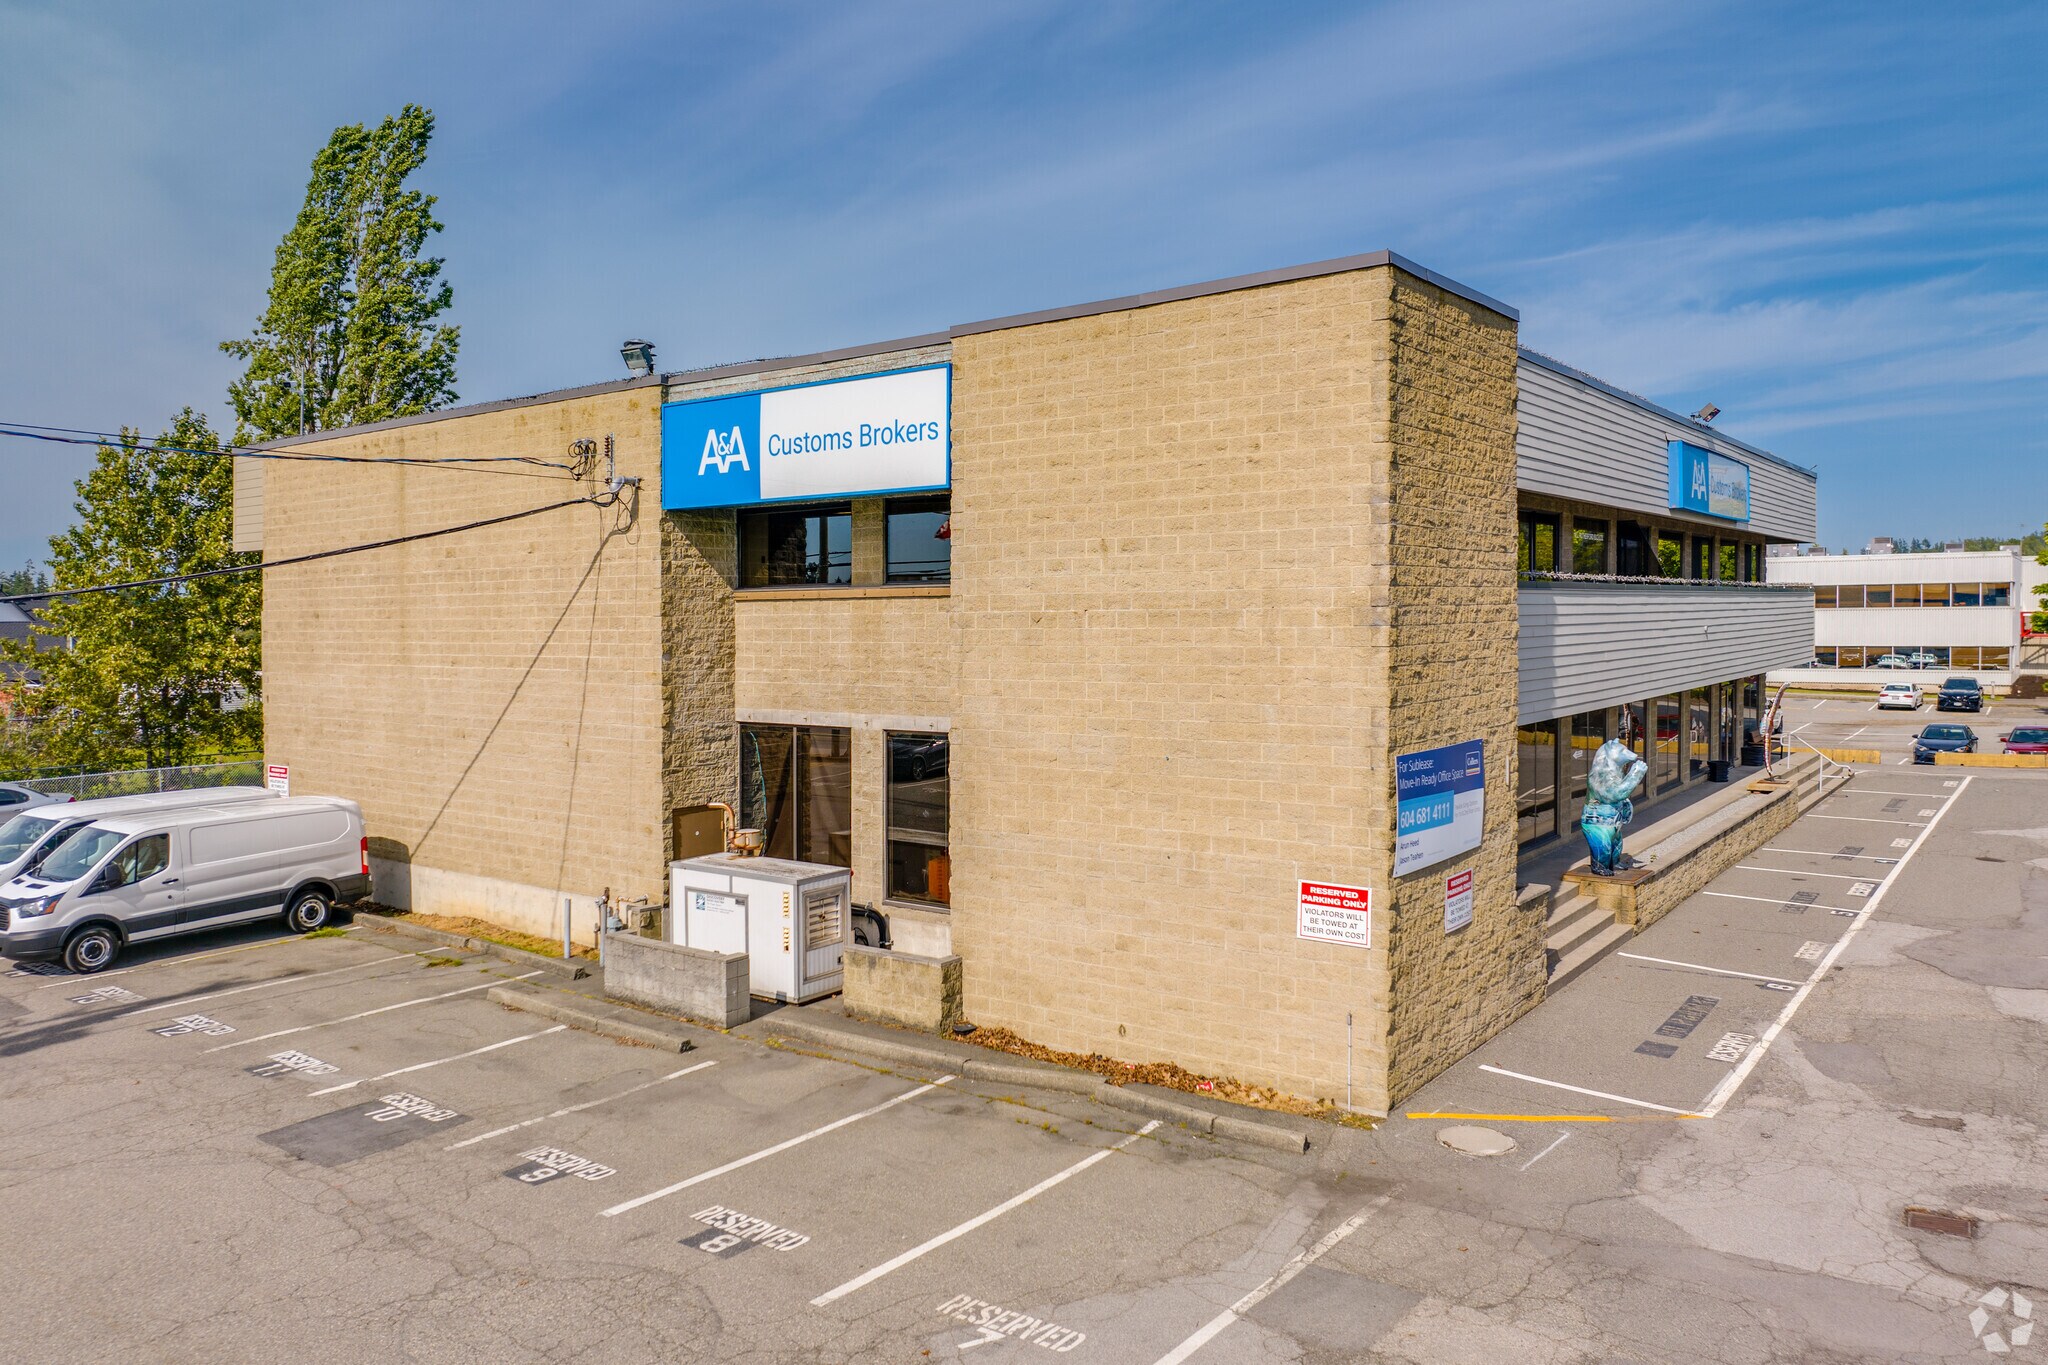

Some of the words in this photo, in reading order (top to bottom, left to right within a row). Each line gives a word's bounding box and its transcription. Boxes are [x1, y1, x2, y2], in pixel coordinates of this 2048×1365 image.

[768, 430, 853, 456] Customs
[859, 419, 939, 447] Brokers
[698, 425, 750, 476] A&A
[1398, 761, 1408, 773] For
[1409, 759, 1435, 772] Sublease:
[1400, 776, 1421, 790] Move-In
[1421, 773, 1438, 787] Ready
[1438, 770, 1451, 783] Office
[1451, 769, 1465, 782] Space
[1400, 810, 1415, 828] 604
[1416, 806, 1431, 825] 681
[1432, 802, 1450, 821] 4111
[1301, 894, 1341, 906] PARKING
[1342, 899, 1367, 909] ONLY
[1309, 887, 1359, 899] RESERVED
[1304, 907, 1345, 919] VIOLATORS
[1345, 913, 1364, 922] WILL
[1310, 917, 1319, 925] BE
[1321, 919, 1347, 929] TOWED
[1303, 925, 1324, 934] THEIR
[1325, 928, 1343, 937] OWN
[1344, 931, 1365, 940] COST
[155, 1025, 193, 1037] 12
[1705, 1031, 1755, 1063] RESERVED
[364, 1106, 409, 1122] 10
[378, 1091, 458, 1122] RESERVED
[517, 1145, 618, 1181] RESERVED
[518, 1167, 558, 1182] 9
[689, 1204, 811, 1252] RESERVED
[698, 1234, 742, 1254] 8
[935, 1293, 1086, 1353] RESERVED
[956, 1327, 1006, 1349] 7
